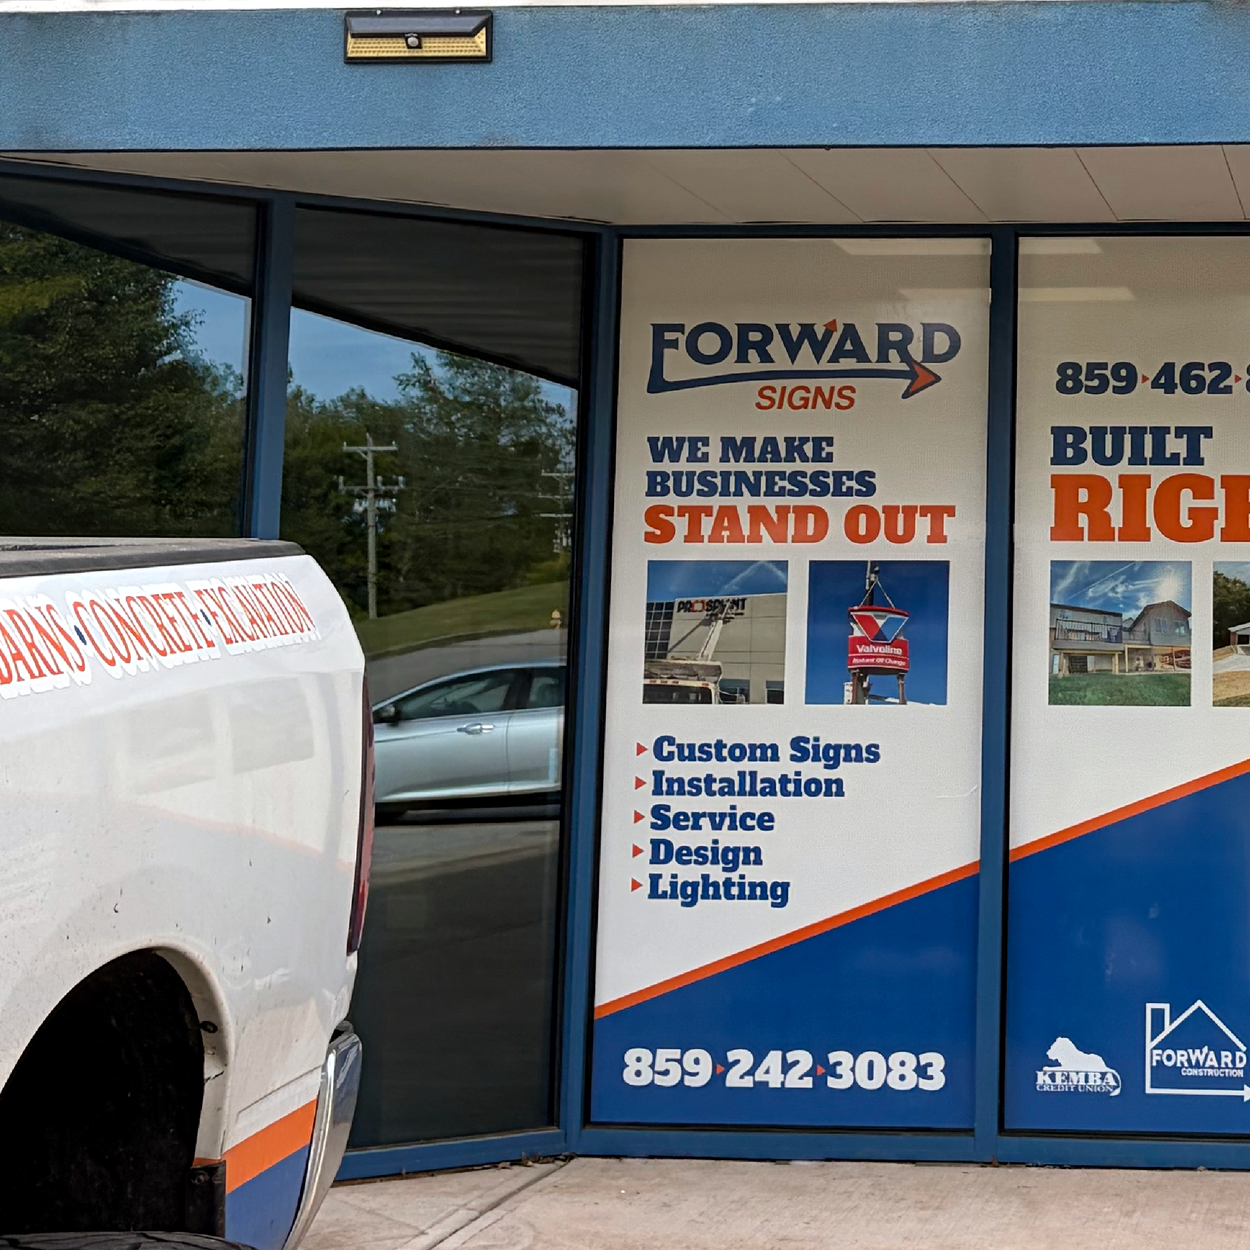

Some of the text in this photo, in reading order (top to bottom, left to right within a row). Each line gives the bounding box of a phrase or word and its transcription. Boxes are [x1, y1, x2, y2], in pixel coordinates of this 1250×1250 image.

[649, 321, 962, 367] FORWARD
[755, 384, 857, 411] SIGNS
[646, 436, 834, 464] WE MAKE
[1049, 426, 1214, 467] BUILT
[645, 470, 877, 498] BUSINESSES
[643, 504, 957, 544] STAND OUT
[73, 591, 216, 667] CONCRETE
[193, 580, 316, 646] EXCAVATION
[652, 735, 881, 770] Custom Signs
[651, 770, 845, 798] Installation
[649, 804, 775, 832] Service
[648, 838, 764, 873] Design
[646, 873, 791, 908] Lighting
[1151, 1048, 1248, 1069] FORWARD
[1035, 1071, 1118, 1087] KEMBA
[1181, 1068, 1244, 1078] CONSTRUCTION
[1035, 1084, 1114, 1093] CREDIT UNION
